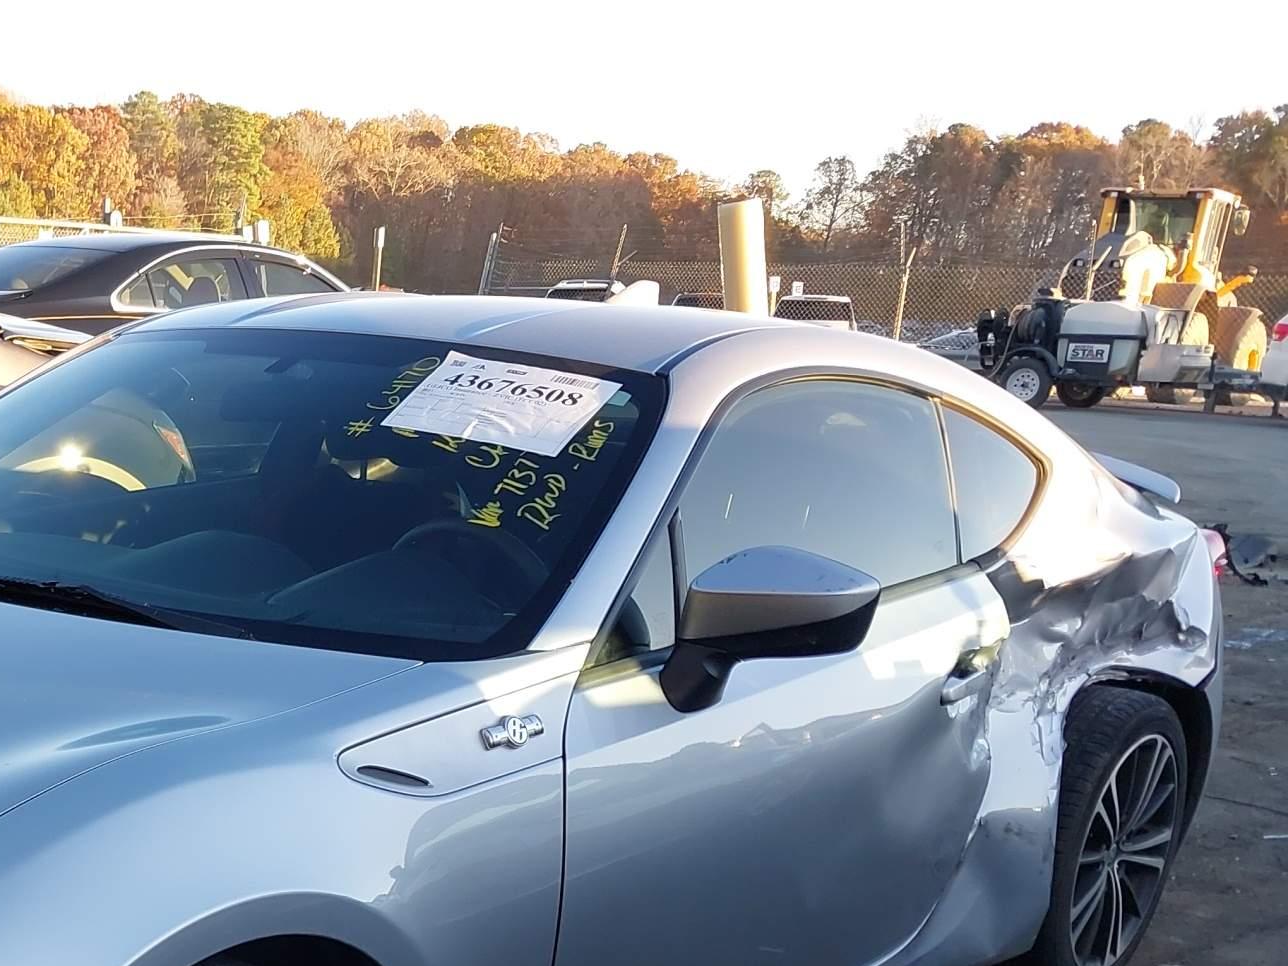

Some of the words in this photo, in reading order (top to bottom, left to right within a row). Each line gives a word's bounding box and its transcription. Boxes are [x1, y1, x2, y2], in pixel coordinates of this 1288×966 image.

[1071, 349, 1105, 358] STAR
[444, 371, 584, 407] 43676508
[344, 416, 375, 437] #
